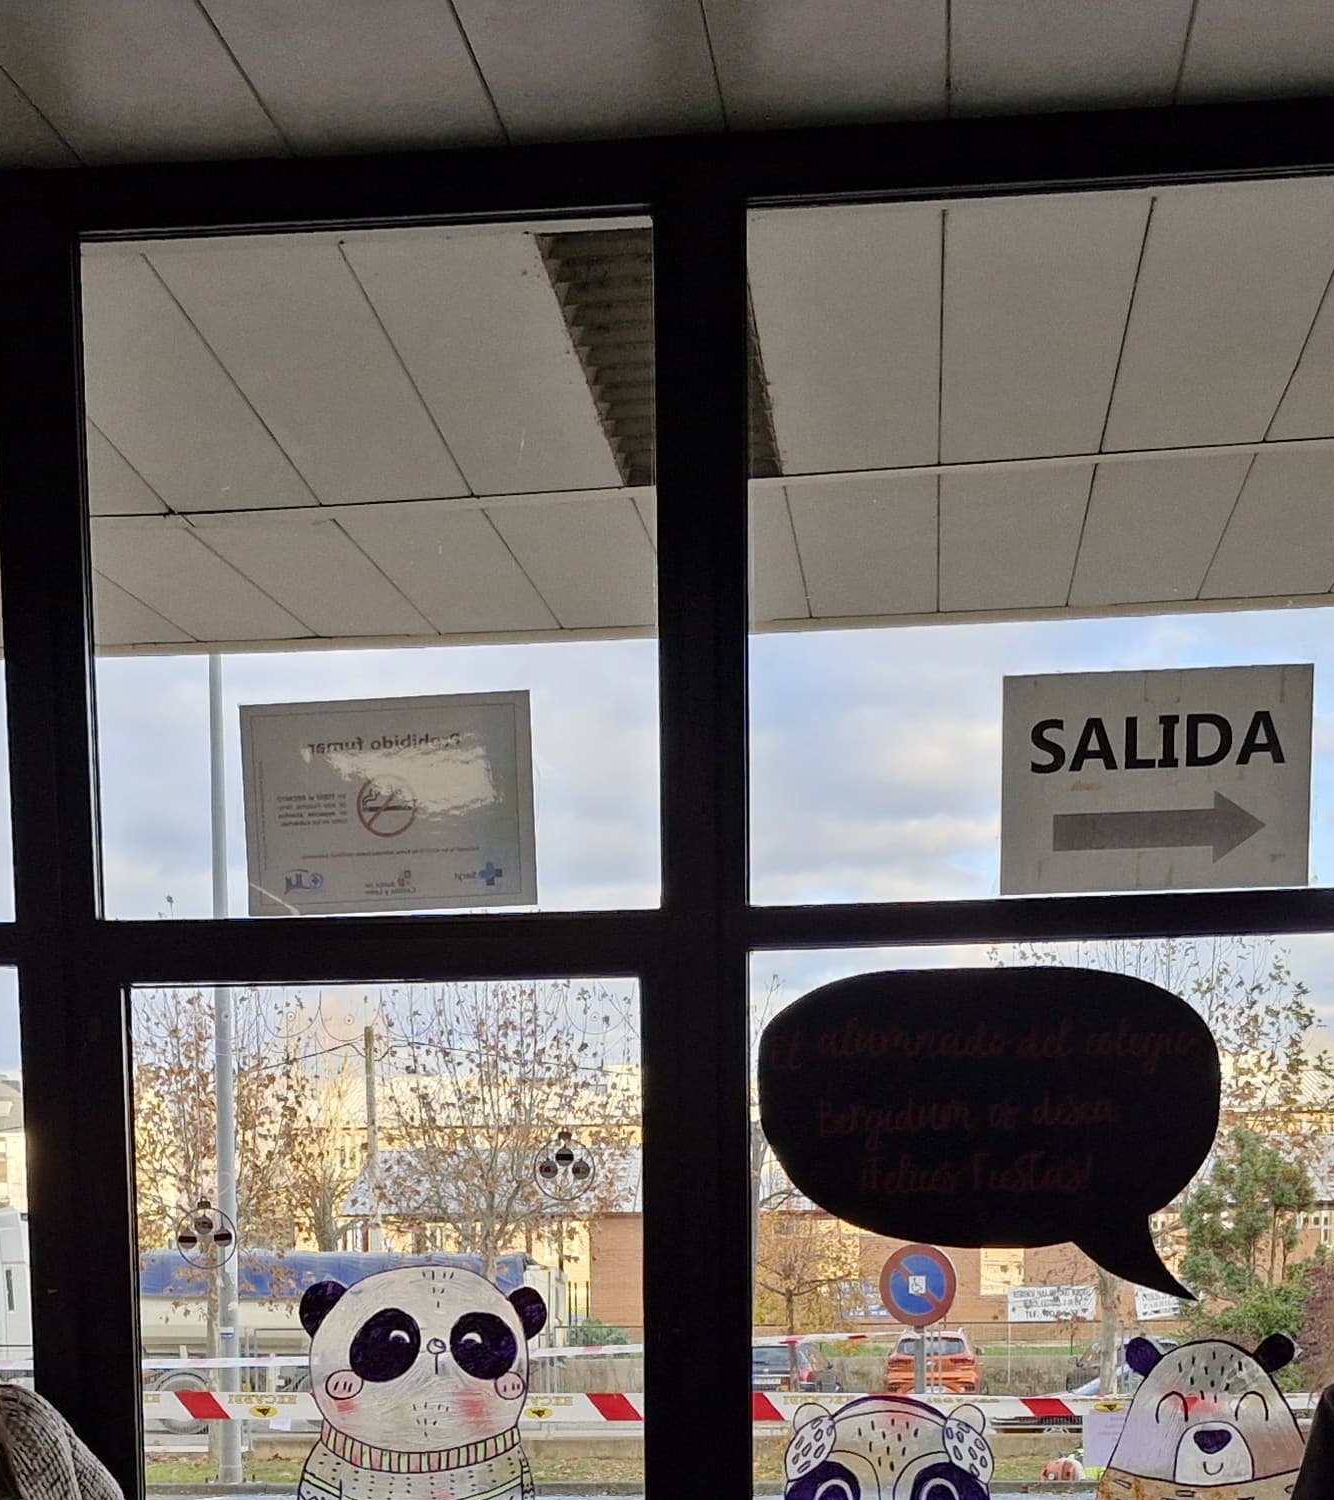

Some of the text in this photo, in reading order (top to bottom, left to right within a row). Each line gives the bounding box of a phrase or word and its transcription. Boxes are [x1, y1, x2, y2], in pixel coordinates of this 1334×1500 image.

[1030, 711, 1286, 774] SALIDA
[817, 1017, 1007, 1058] alumnado
[1016, 1017, 1074, 1058] del
[1084, 1018, 1197, 1075] colegio
[987, 1101, 1019, 1131] os
